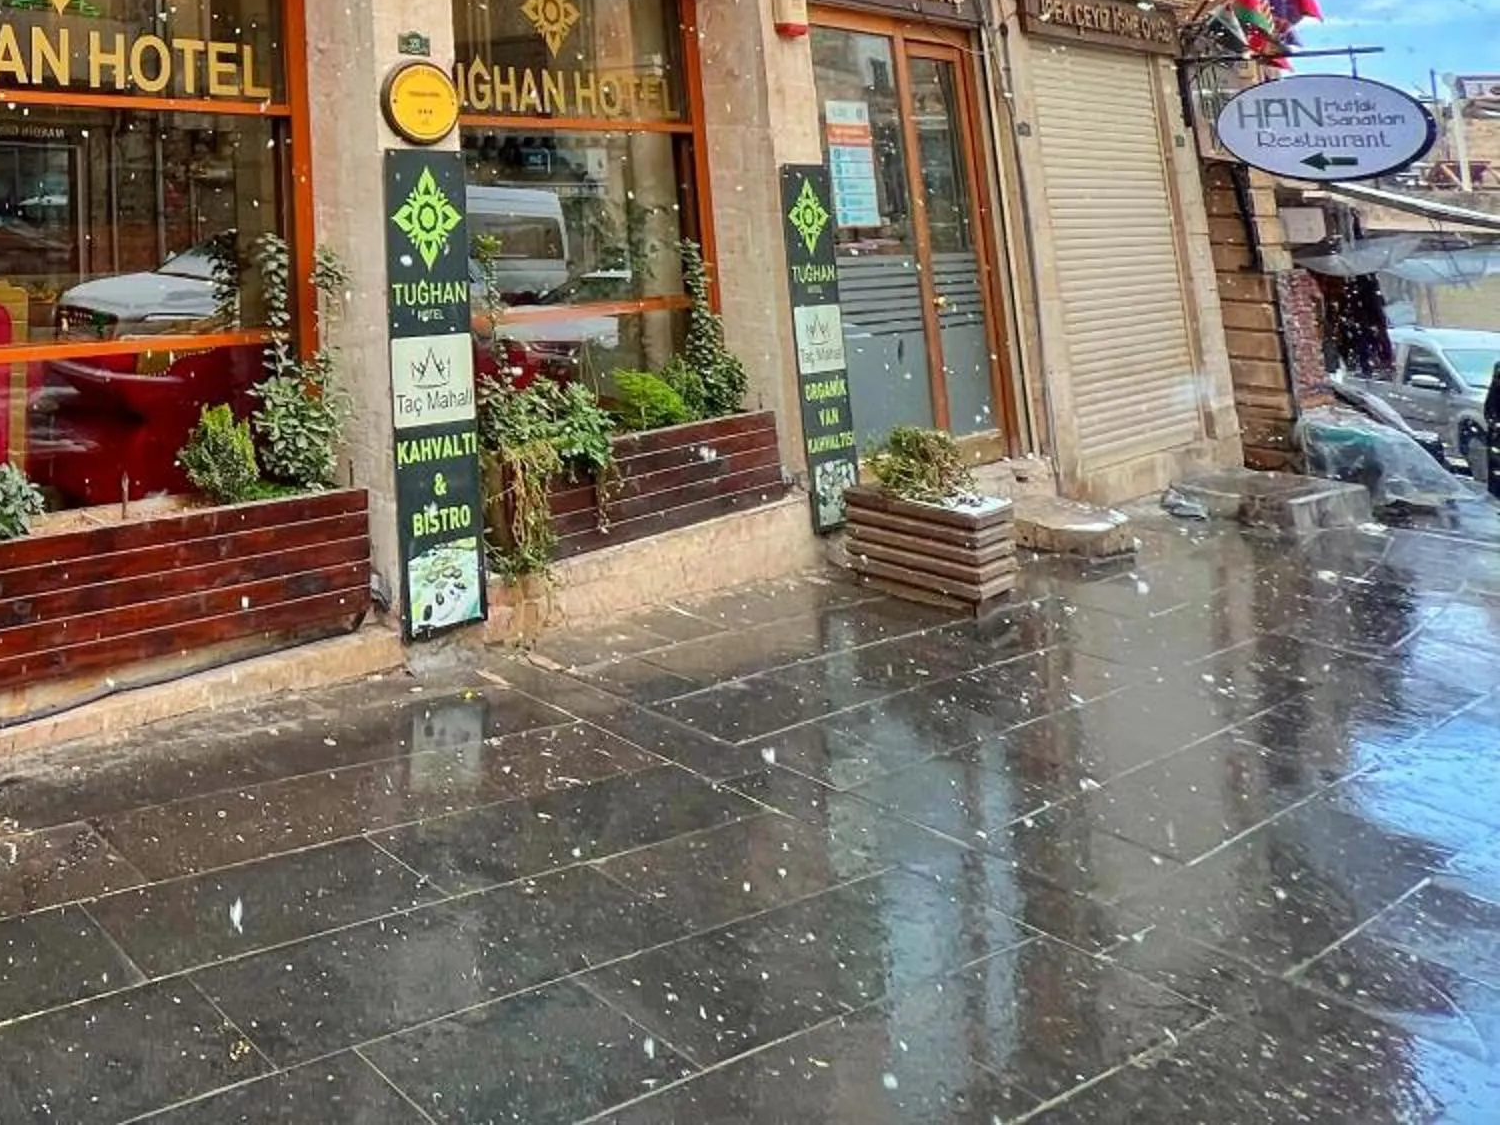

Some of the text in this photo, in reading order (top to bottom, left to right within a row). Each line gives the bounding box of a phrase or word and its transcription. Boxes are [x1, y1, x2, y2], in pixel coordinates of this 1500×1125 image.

[89, 31, 271, 99] HOTEL
[574, 70, 680, 119] HOTEL
[1236, 96, 1325, 128] HAN
[1256, 130, 1391, 148] Restaurant
[395, 394, 422, 417] Taç
[397, 432, 477, 465] KAHVALTI
[433, 472, 447, 496] &
